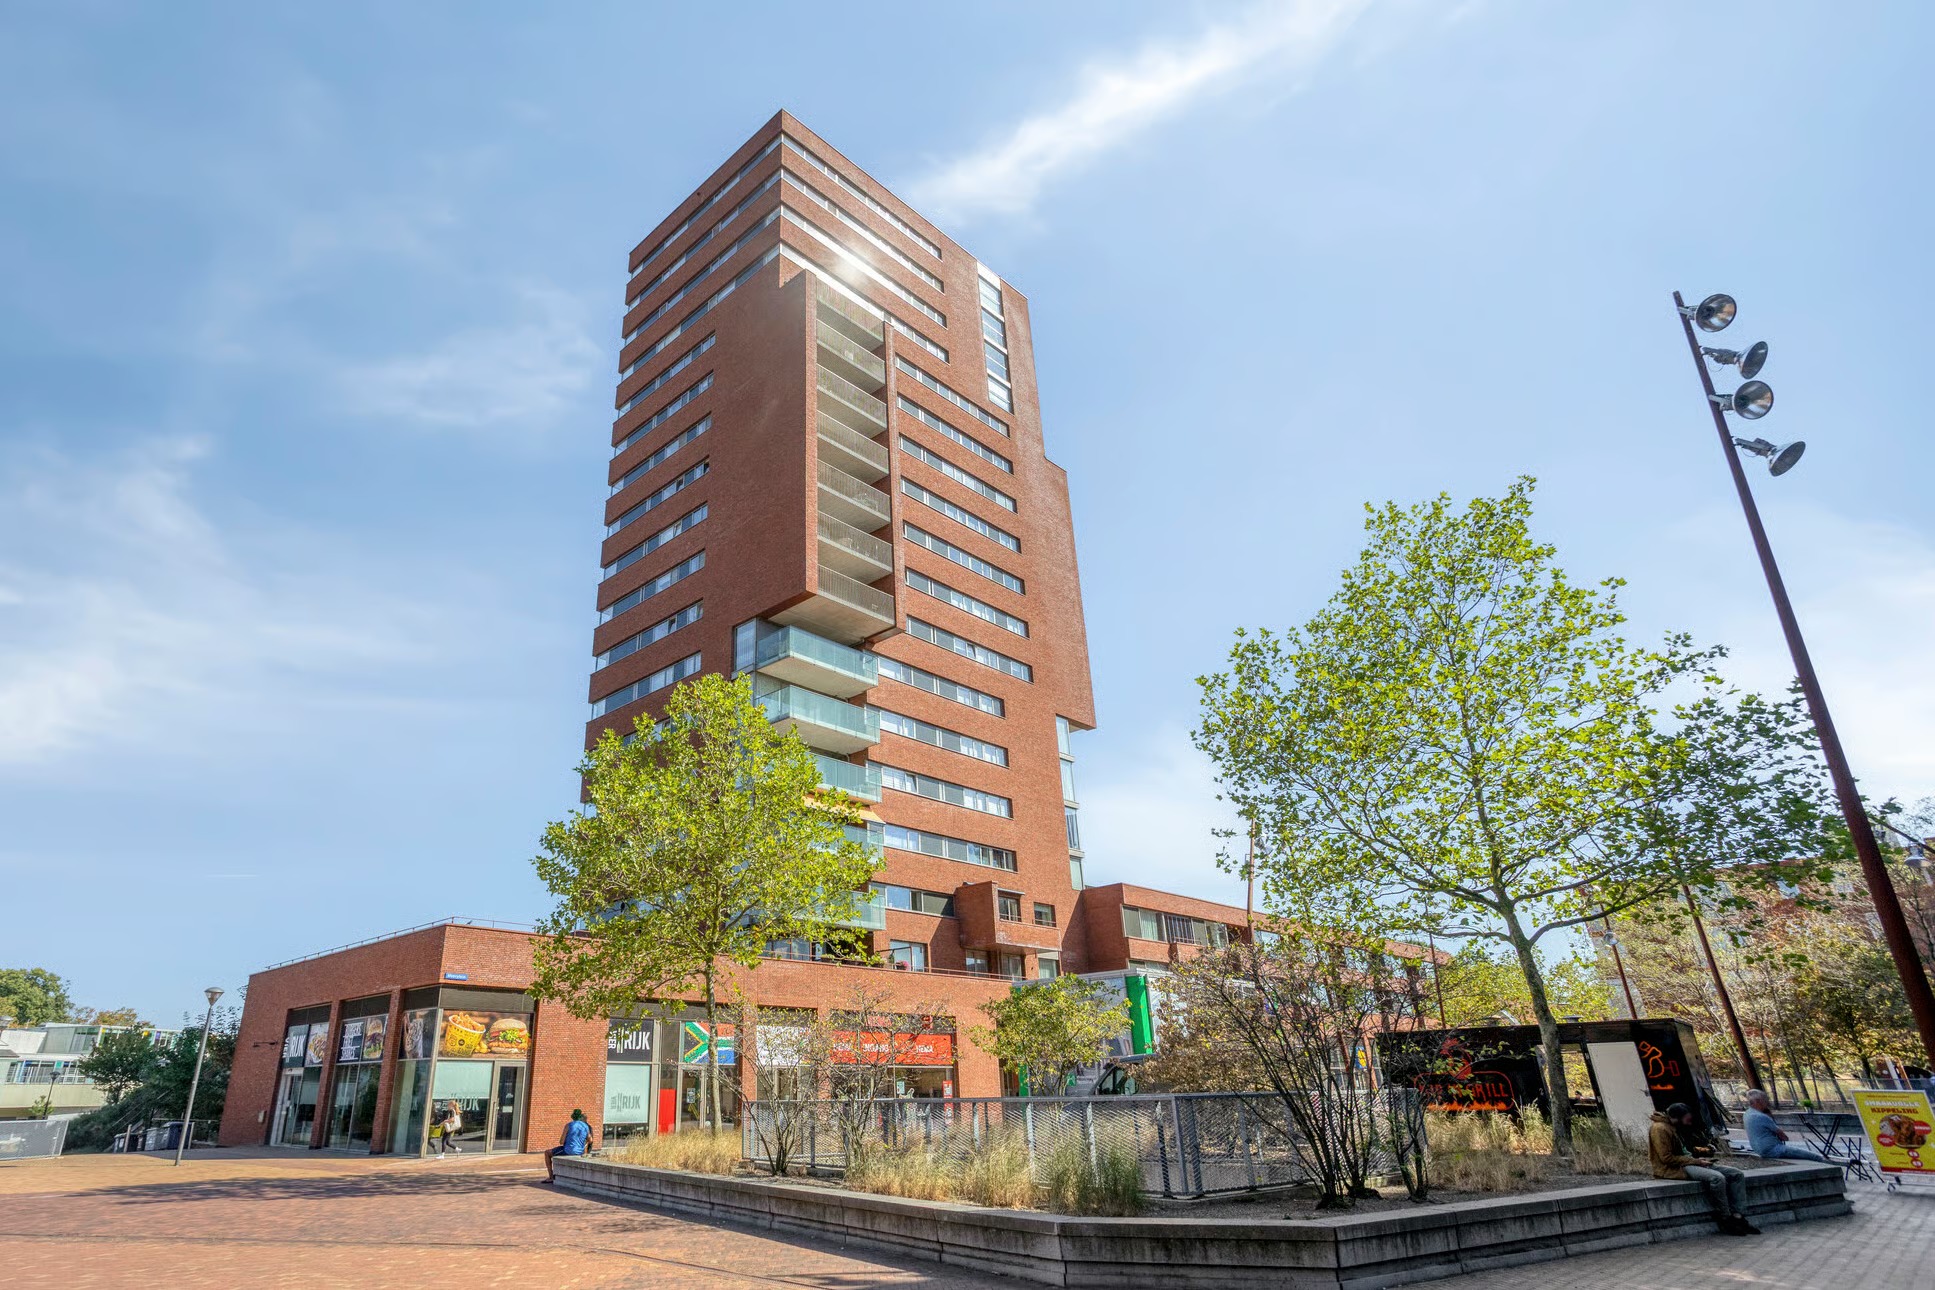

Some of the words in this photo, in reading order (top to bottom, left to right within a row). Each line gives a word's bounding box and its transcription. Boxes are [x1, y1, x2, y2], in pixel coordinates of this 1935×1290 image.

[289, 1034, 306, 1057] RIJK
[624, 1031, 651, 1050] RIJK
[1466, 1082, 1508, 1101] GRILL
[622, 1095, 641, 1110] RIJK
